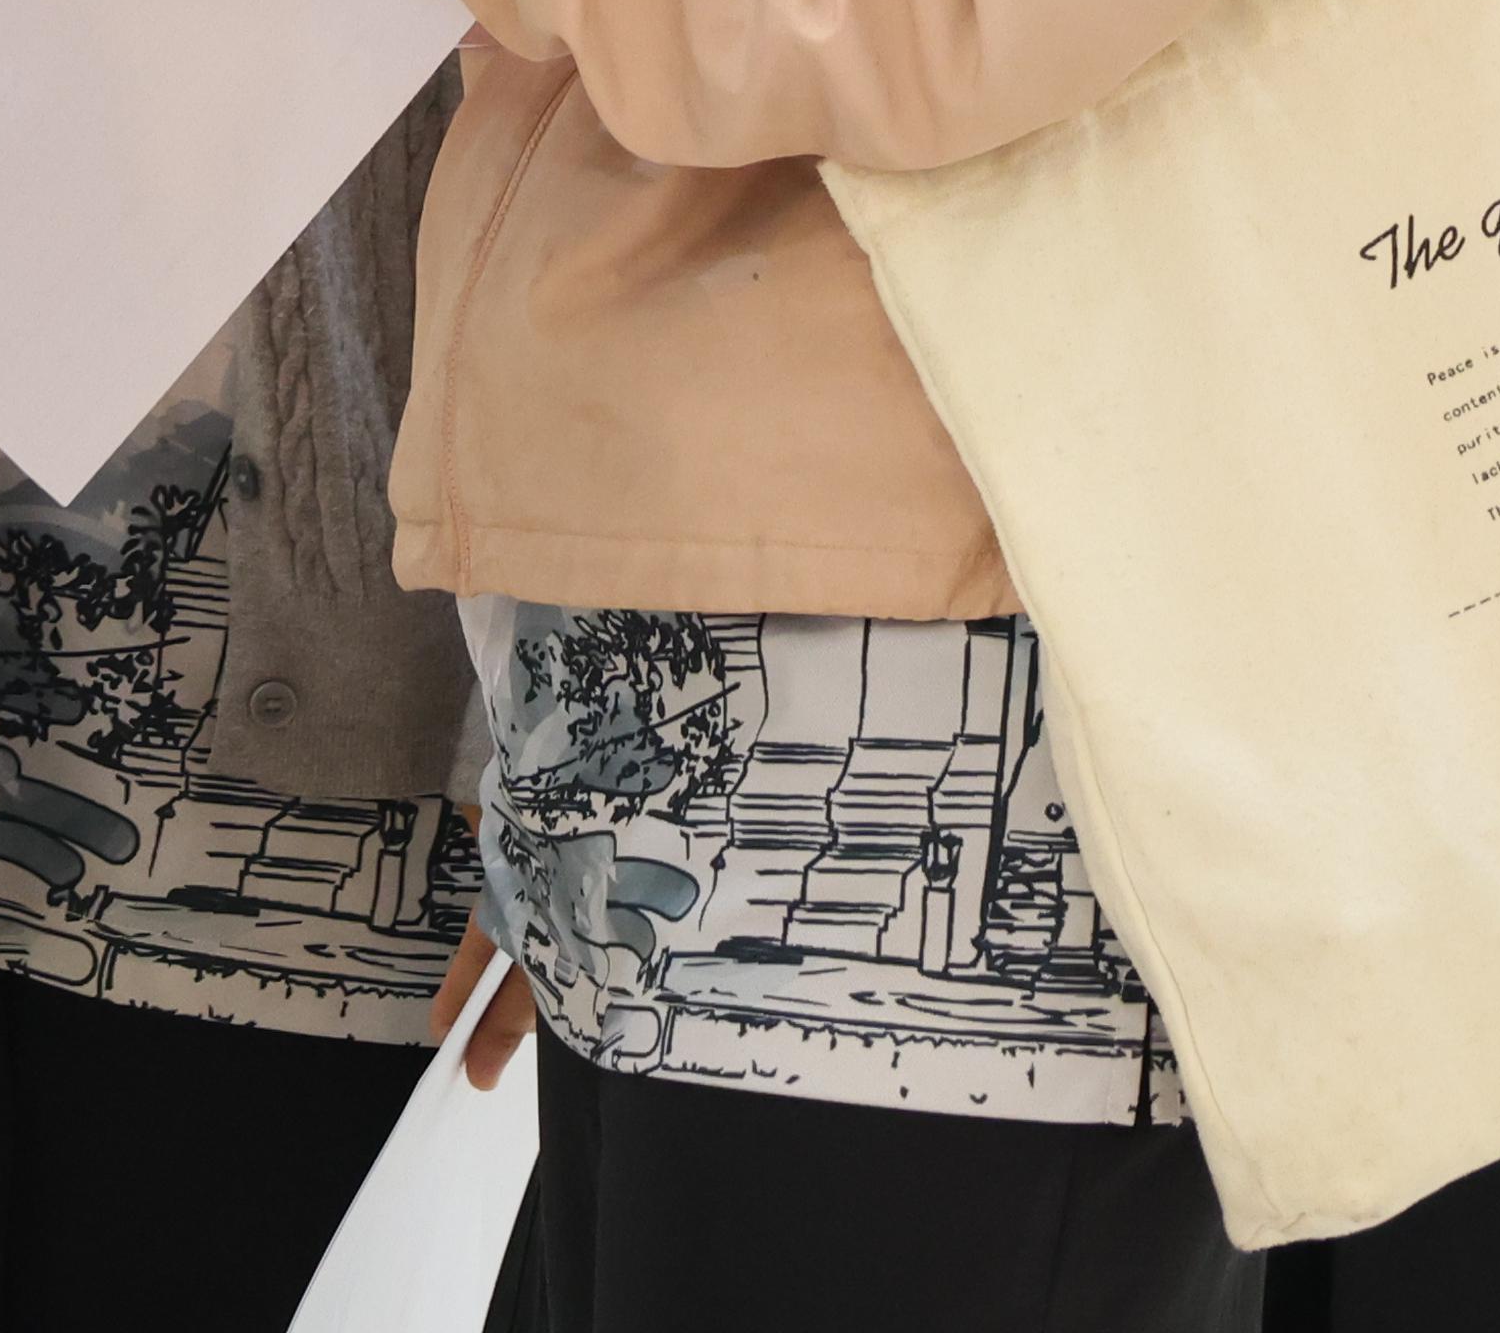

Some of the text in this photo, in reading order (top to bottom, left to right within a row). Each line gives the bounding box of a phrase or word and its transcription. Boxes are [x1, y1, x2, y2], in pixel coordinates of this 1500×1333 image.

[1360, 214, 1466, 290] The
[1427, 358, 1474, 386] Peace
[1482, 345, 1500, 360] is
